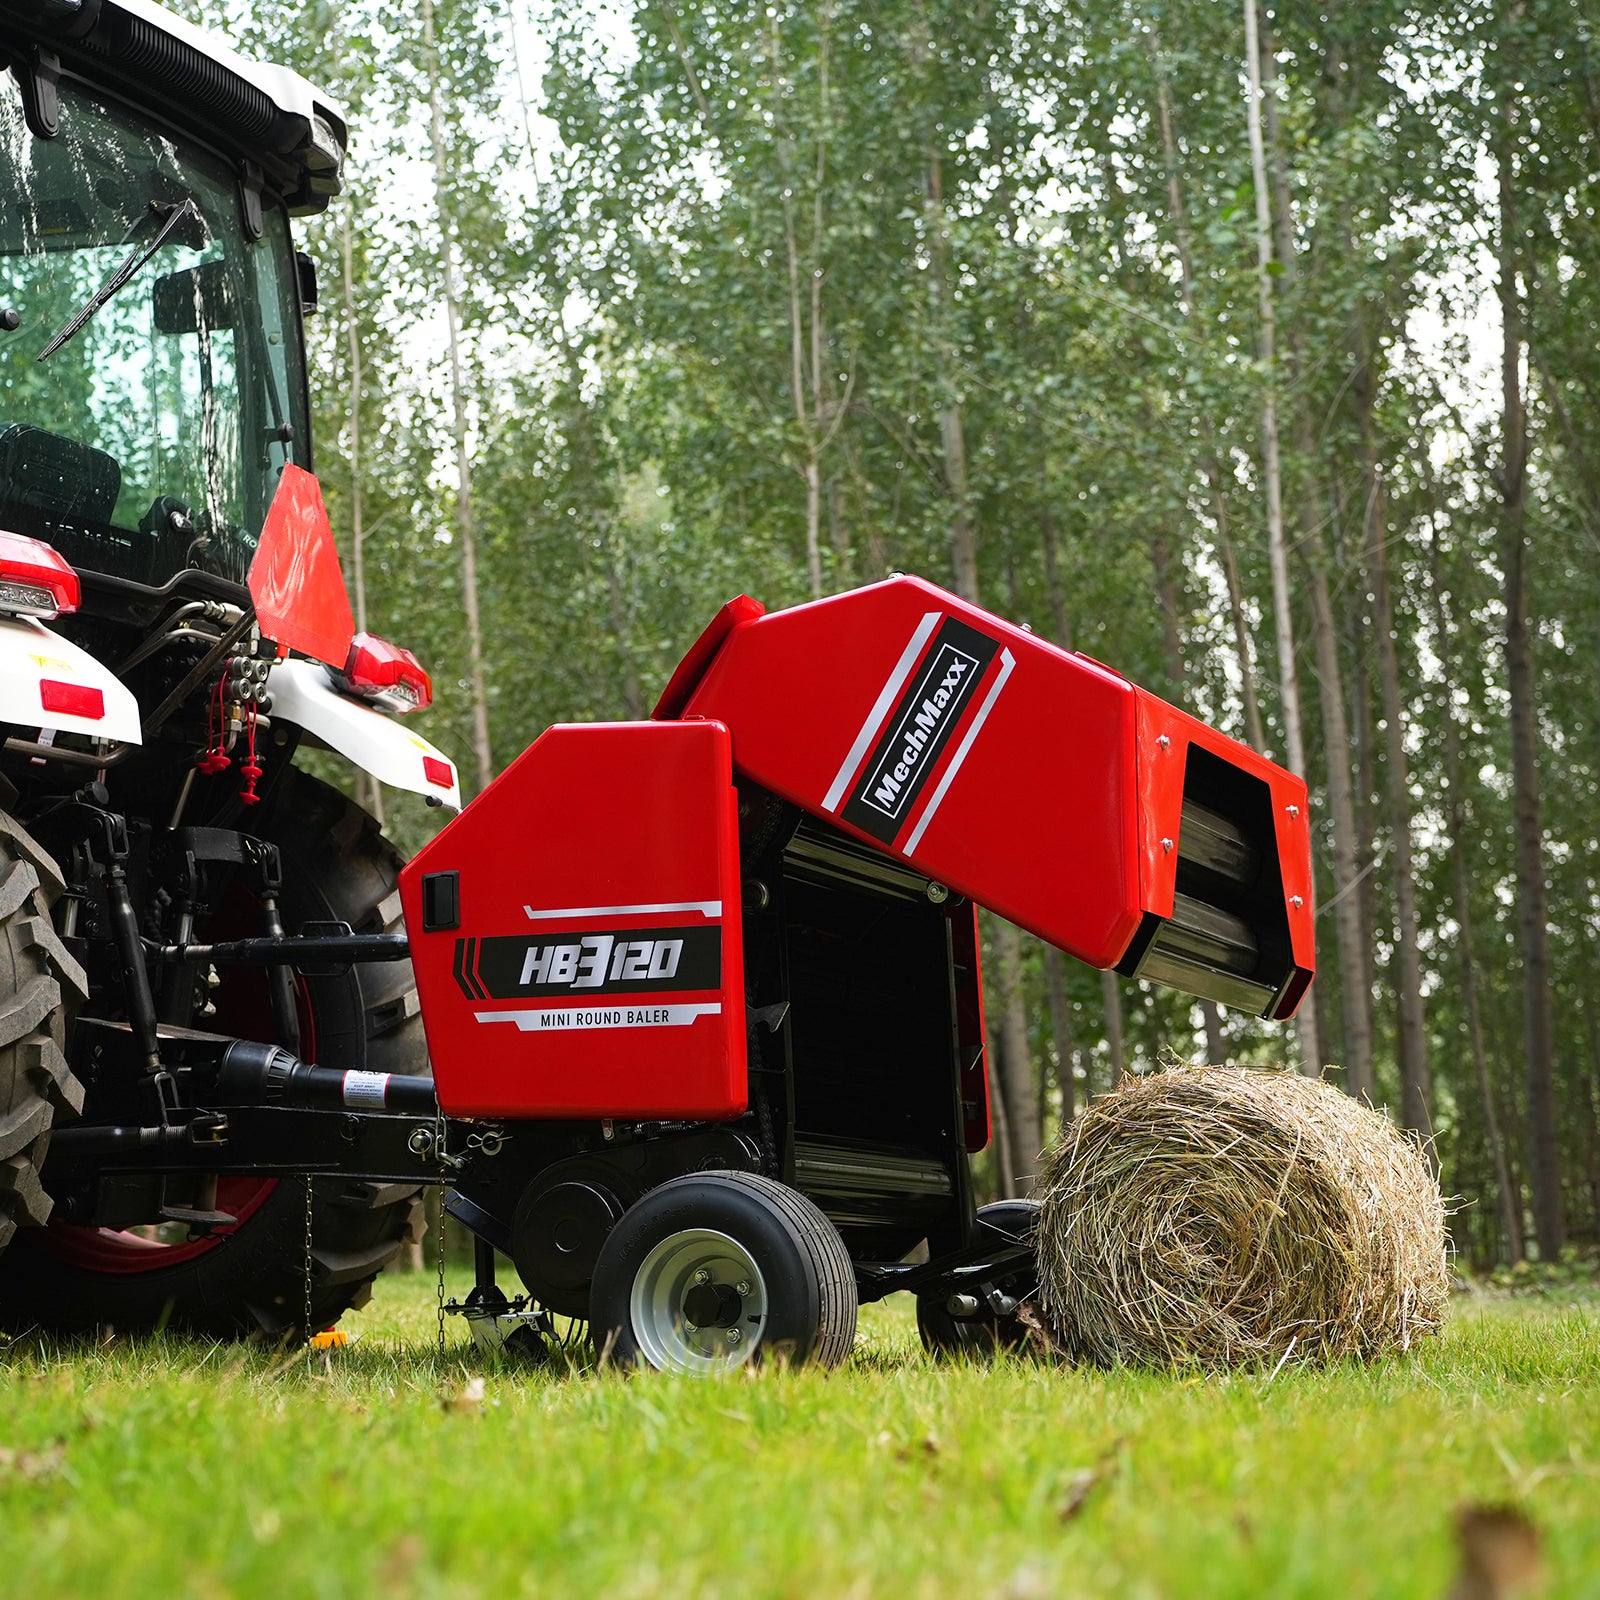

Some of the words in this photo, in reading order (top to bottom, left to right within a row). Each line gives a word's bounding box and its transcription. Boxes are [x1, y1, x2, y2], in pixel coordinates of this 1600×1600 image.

[874, 657, 968, 809] MechMaxx
[519, 935, 684, 988] HB3120
[540, 1012, 571, 1027] MINI
[576, 1011, 621, 1026] ROUND
[627, 1009, 670, 1025] BALER
